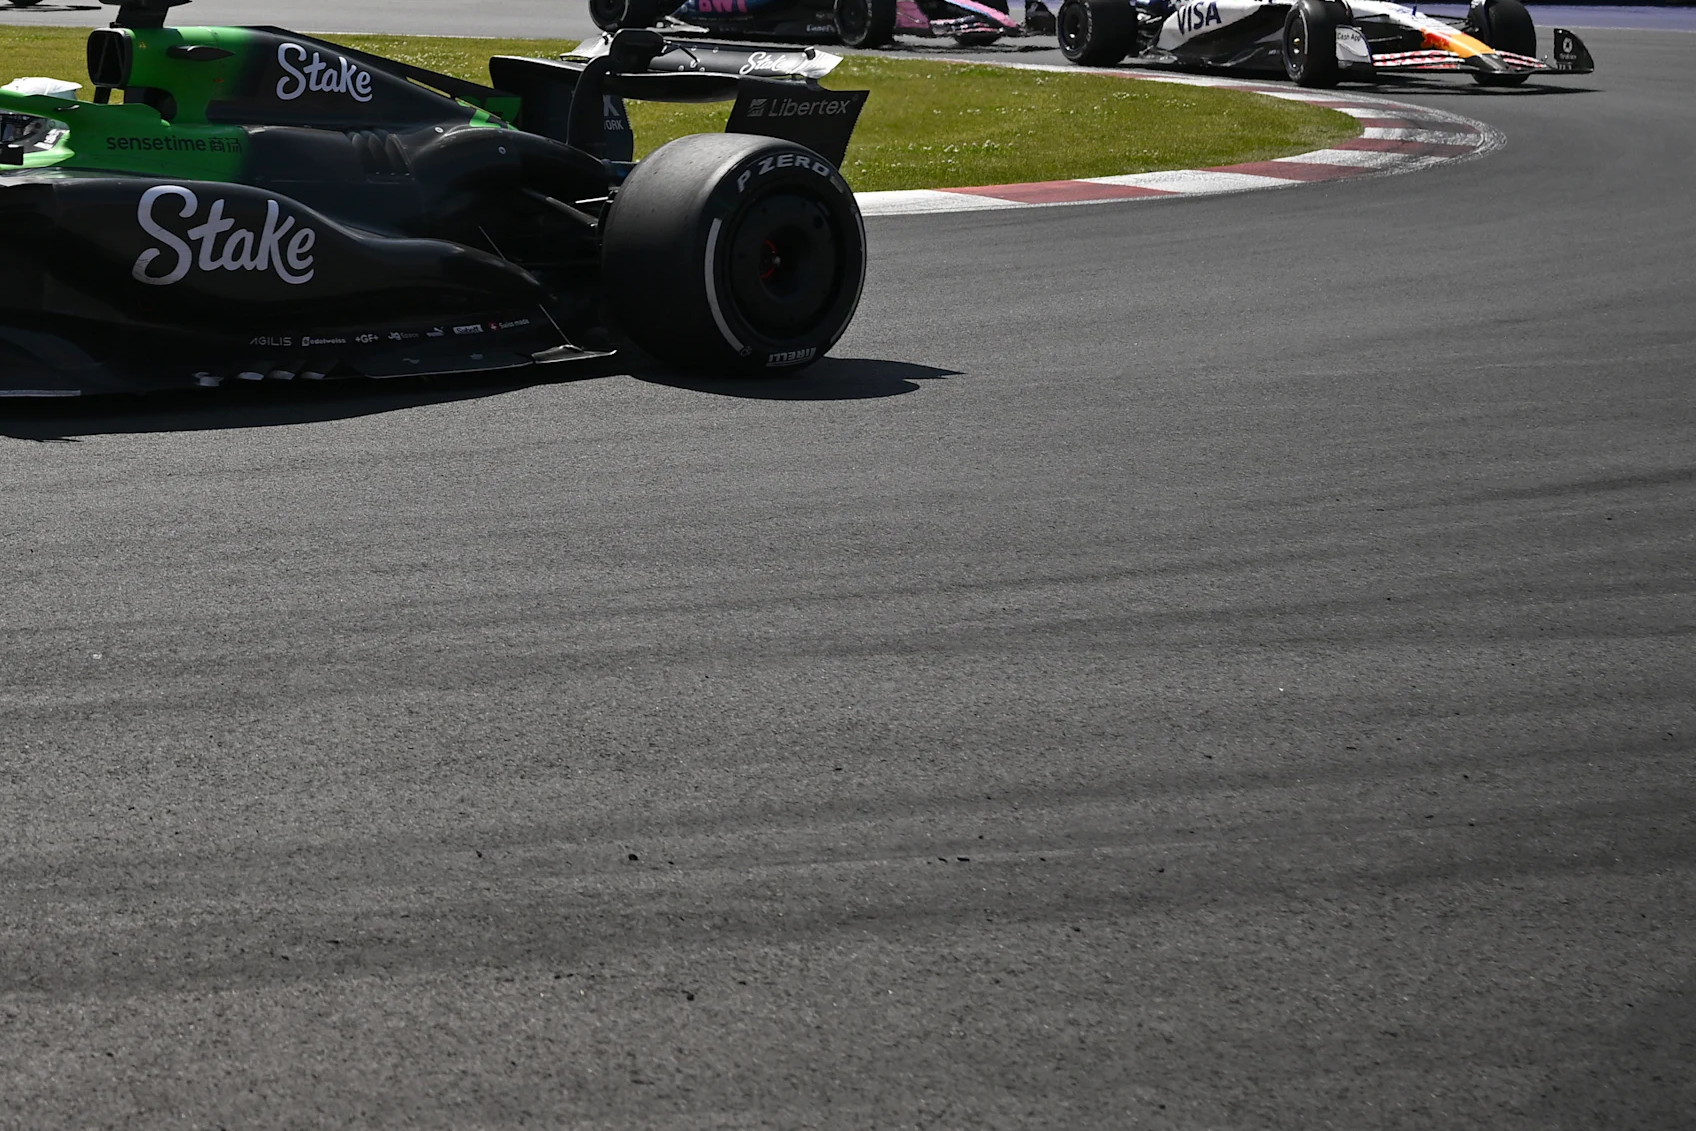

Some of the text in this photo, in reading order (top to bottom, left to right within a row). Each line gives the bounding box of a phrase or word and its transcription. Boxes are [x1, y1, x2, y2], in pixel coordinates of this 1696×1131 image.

[1177, 1, 1222, 35] VISA
[276, 42, 373, 102] Stake
[768, 98, 850, 117] Libertex
[107, 135, 207, 151] sensetime
[736, 153, 831, 193] P ZERO
[132, 185, 316, 286] Stake
[765, 346, 817, 367] PIRELLI
